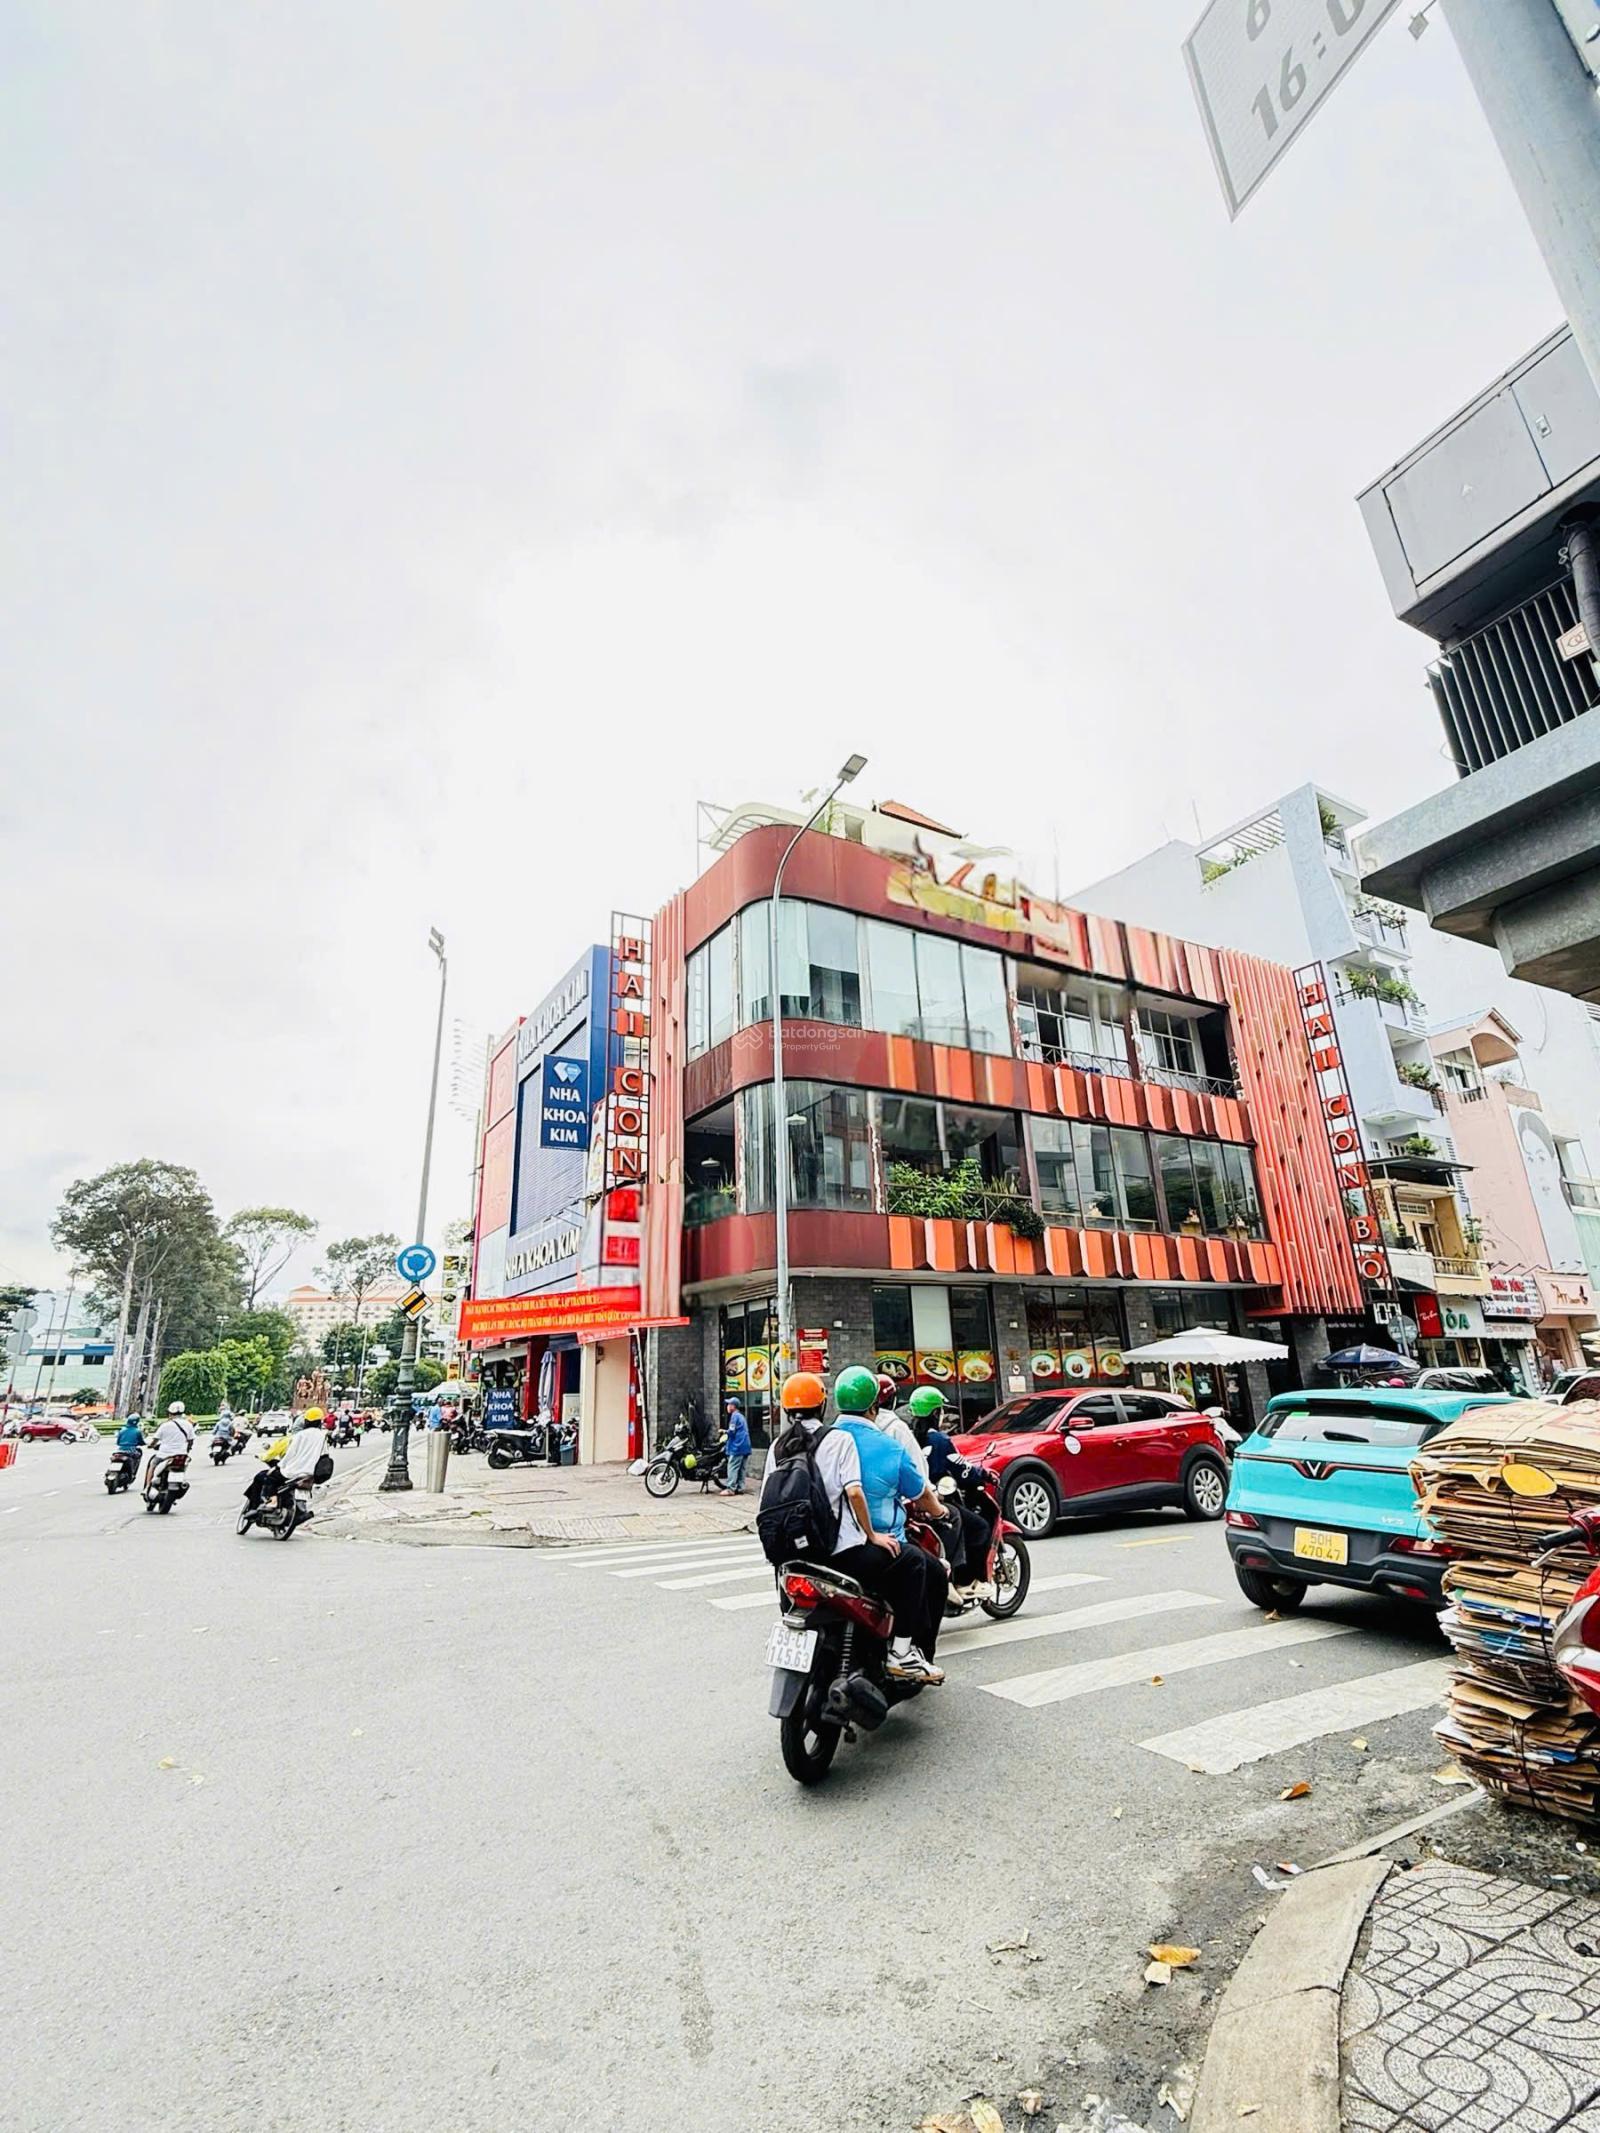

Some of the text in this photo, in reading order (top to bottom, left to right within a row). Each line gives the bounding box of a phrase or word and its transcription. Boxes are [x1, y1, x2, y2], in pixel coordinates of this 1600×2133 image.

[622, 937, 643, 1034] HAI
[549, 1087, 581, 1103] NHA
[1302, 986, 1334, 1070] HAI
[1326, 1097, 1360, 1189] CON
[543, 1108, 587, 1124] KHOA
[618, 1070, 641, 1174] CON
[549, 1128, 578, 1143] KIM
[505, 1252, 526, 1281] NHA
[526, 1237, 557, 1273] KHOA
[557, 1226, 581, 1261] KIM
[492, 1391, 511, 1400] NHA
[488, 1402, 514, 1412] KHOA
[491, 1414, 509, 1423] KIM
[1310, 1533, 1332, 1547] 50H
